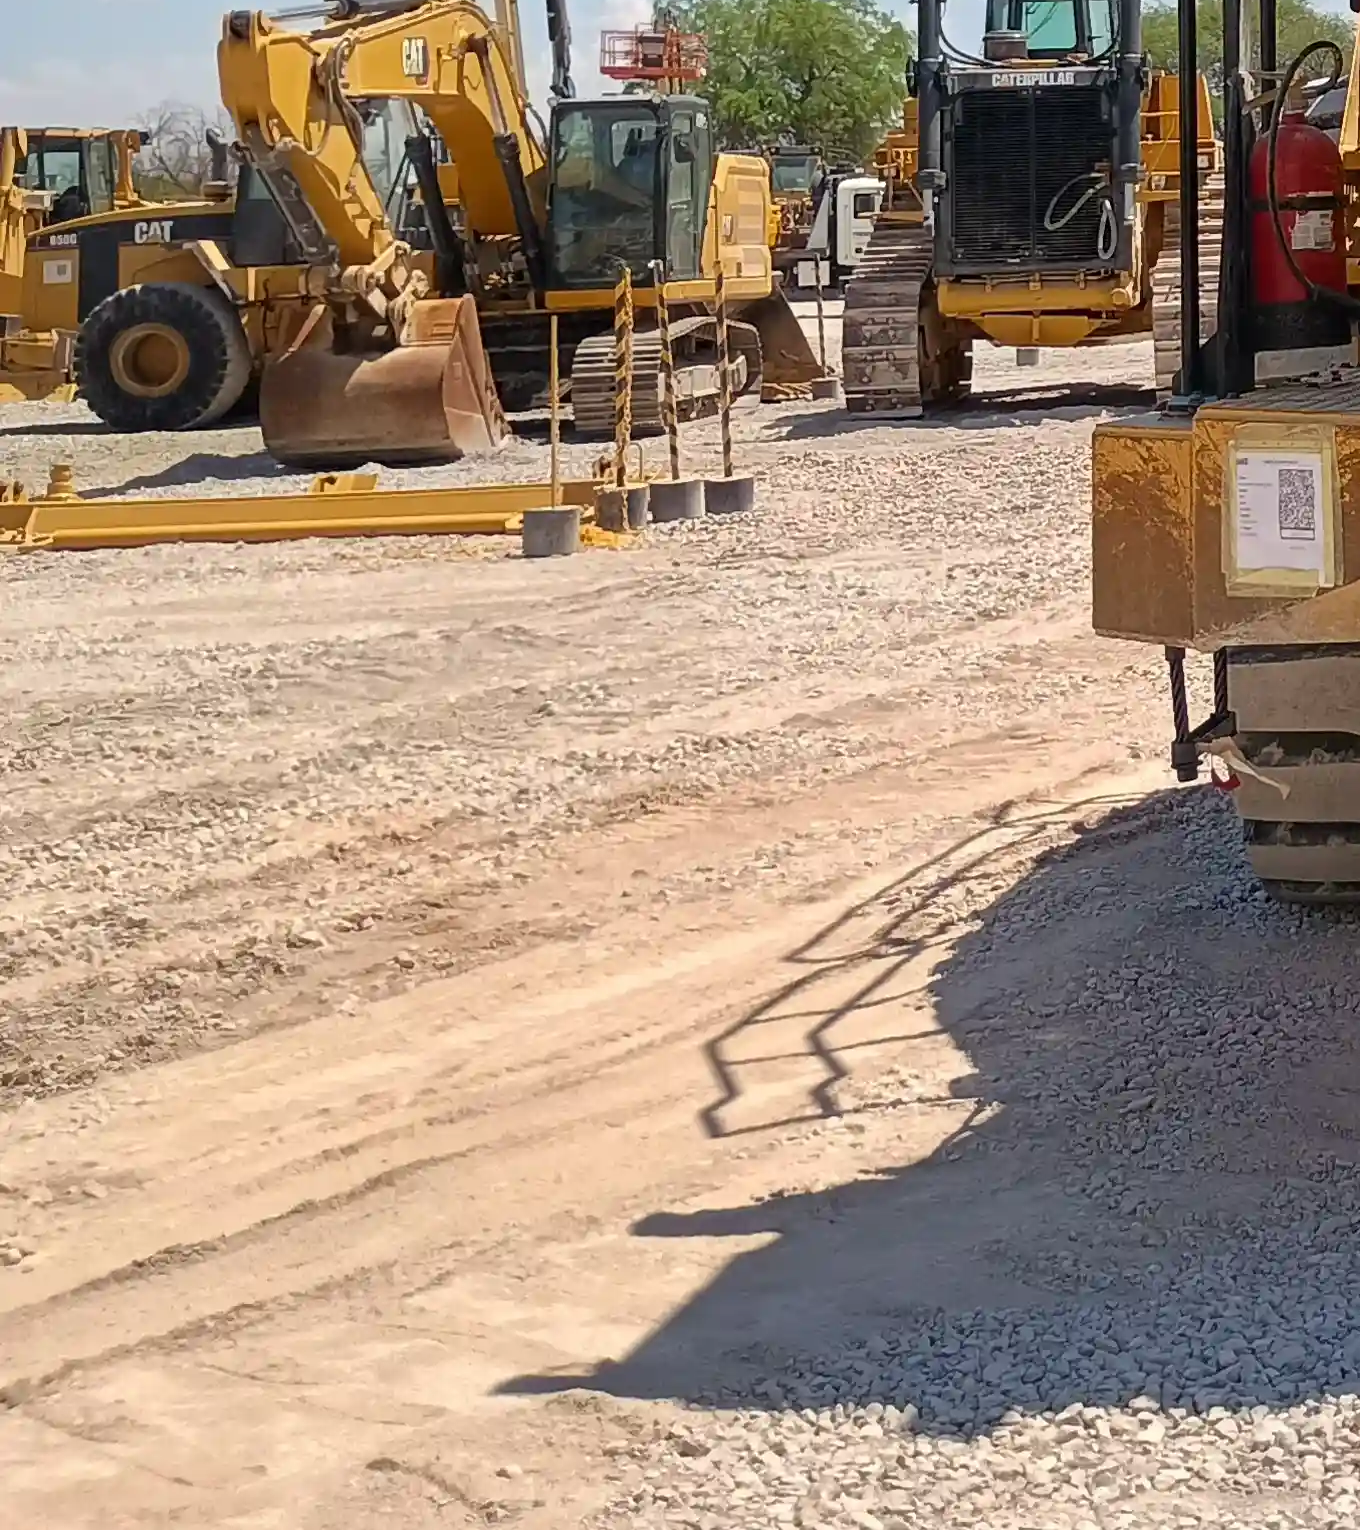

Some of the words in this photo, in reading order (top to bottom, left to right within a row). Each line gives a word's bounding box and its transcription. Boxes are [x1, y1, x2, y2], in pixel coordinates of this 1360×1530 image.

[402, 38, 424, 75] CAT
[991, 71, 1076, 87] CATERPILLAR
[134, 221, 174, 244] CAT
